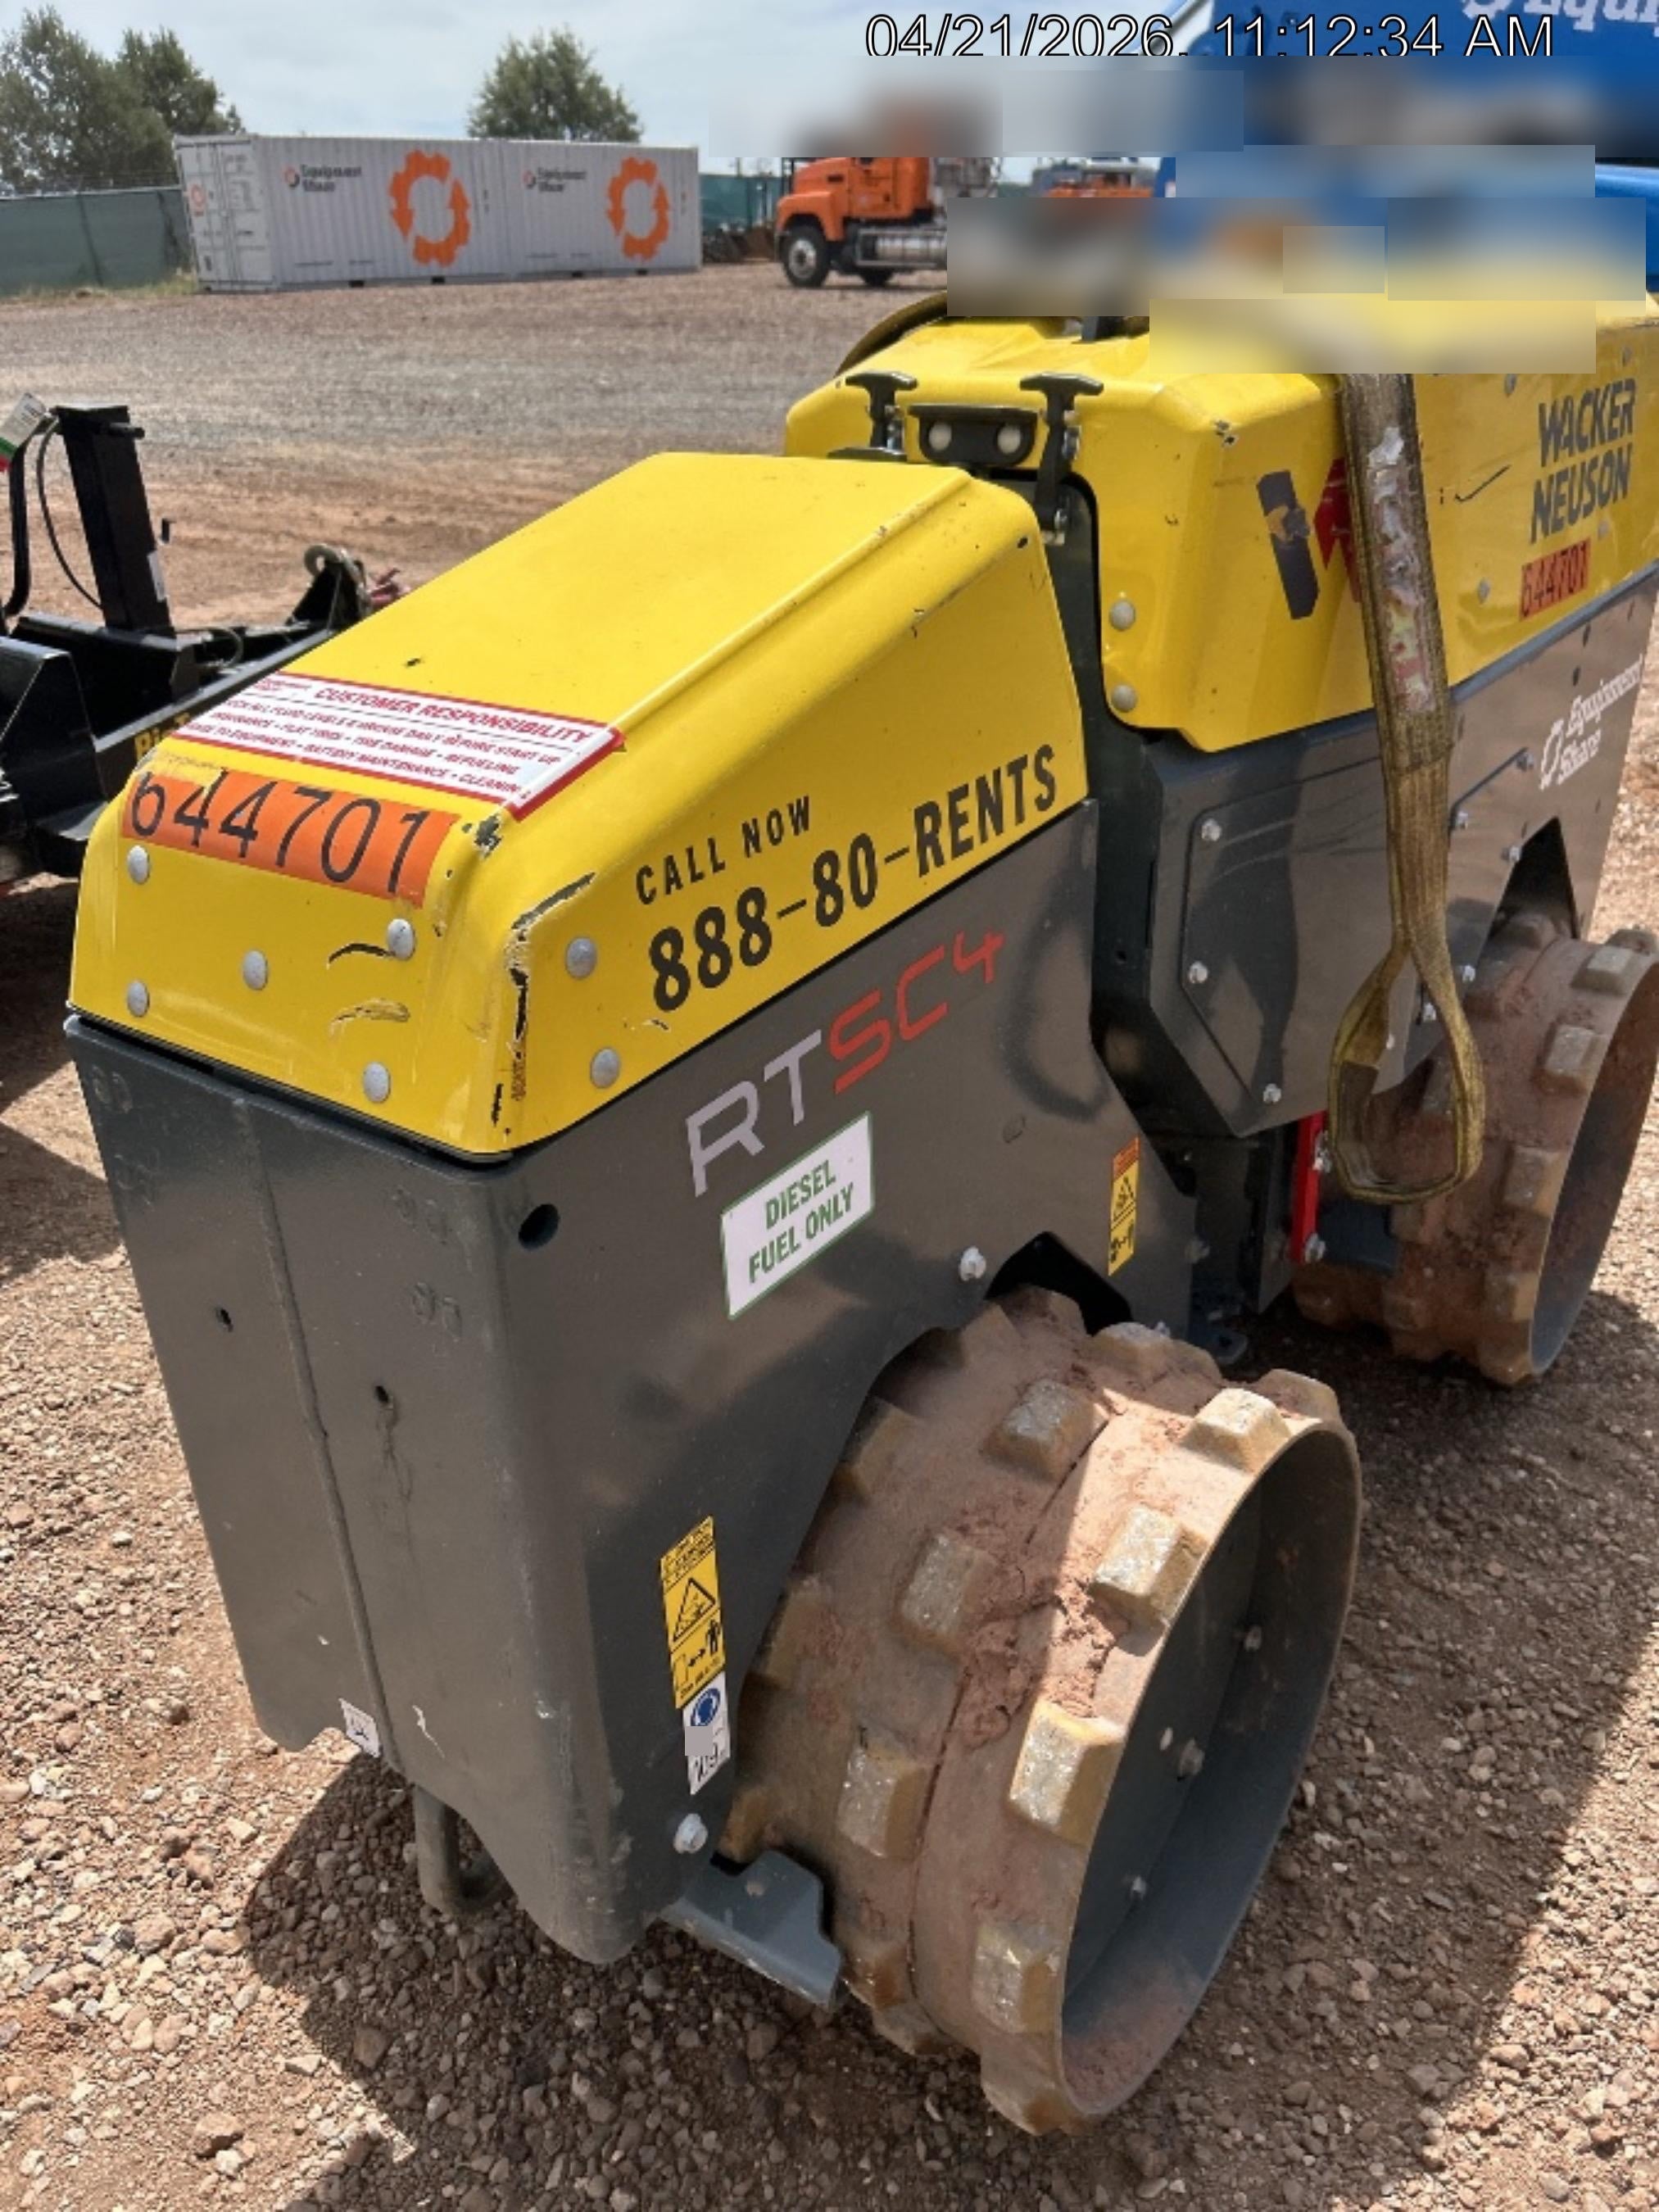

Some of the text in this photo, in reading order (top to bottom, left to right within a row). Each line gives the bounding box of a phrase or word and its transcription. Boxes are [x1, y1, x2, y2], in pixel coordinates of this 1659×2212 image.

[1522, 0, 1659, 39] qui
[1538, 378, 1636, 468] WACKER
[1530, 442, 1633, 545] NEUSON
[1521, 540, 1588, 618] 644701
[315, 687, 593, 743] CUSTOMER RESPONSIBILITY
[496, 746, 537, 760] START
[358, 754, 445, 777] MAINTENANCE
[131, 768, 432, 894] 644701
[635, 795, 810, 905] CALL NOW
[648, 744, 1057, 1013] 888-80-RENTS
[686, 931, 1006, 1198] RTSC4
[749, 1181, 853, 1283] FUEL ONLY
[765, 1159, 836, 1230] DIESEL
